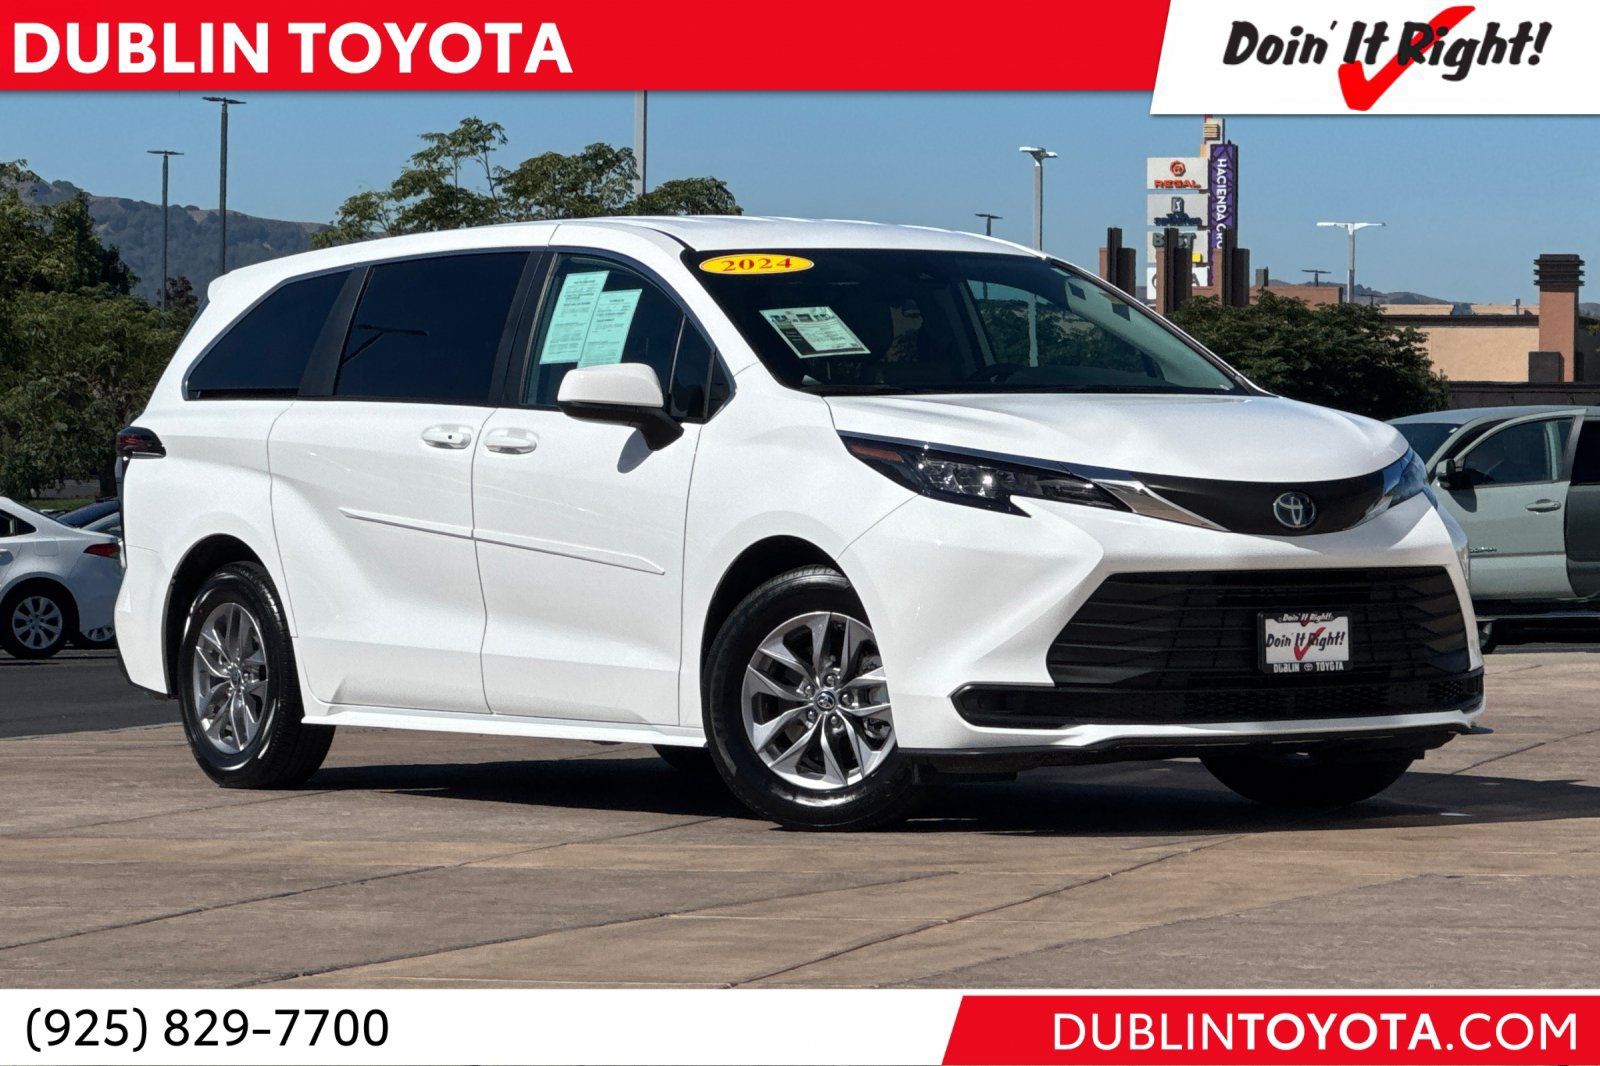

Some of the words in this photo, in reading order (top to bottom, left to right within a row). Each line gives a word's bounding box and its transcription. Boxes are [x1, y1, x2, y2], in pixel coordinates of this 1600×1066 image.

[1154, 179, 1201, 189] REGAL
[1216, 158, 1227, 221] HACIENDA
[721, 258, 792, 271] 2024
[1295, 632, 1306, 647] It
[1308, 632, 1345, 651] Right!
[1273, 663, 1300, 673] DUBLIN
[1316, 661, 1344, 672] TOYOTA
